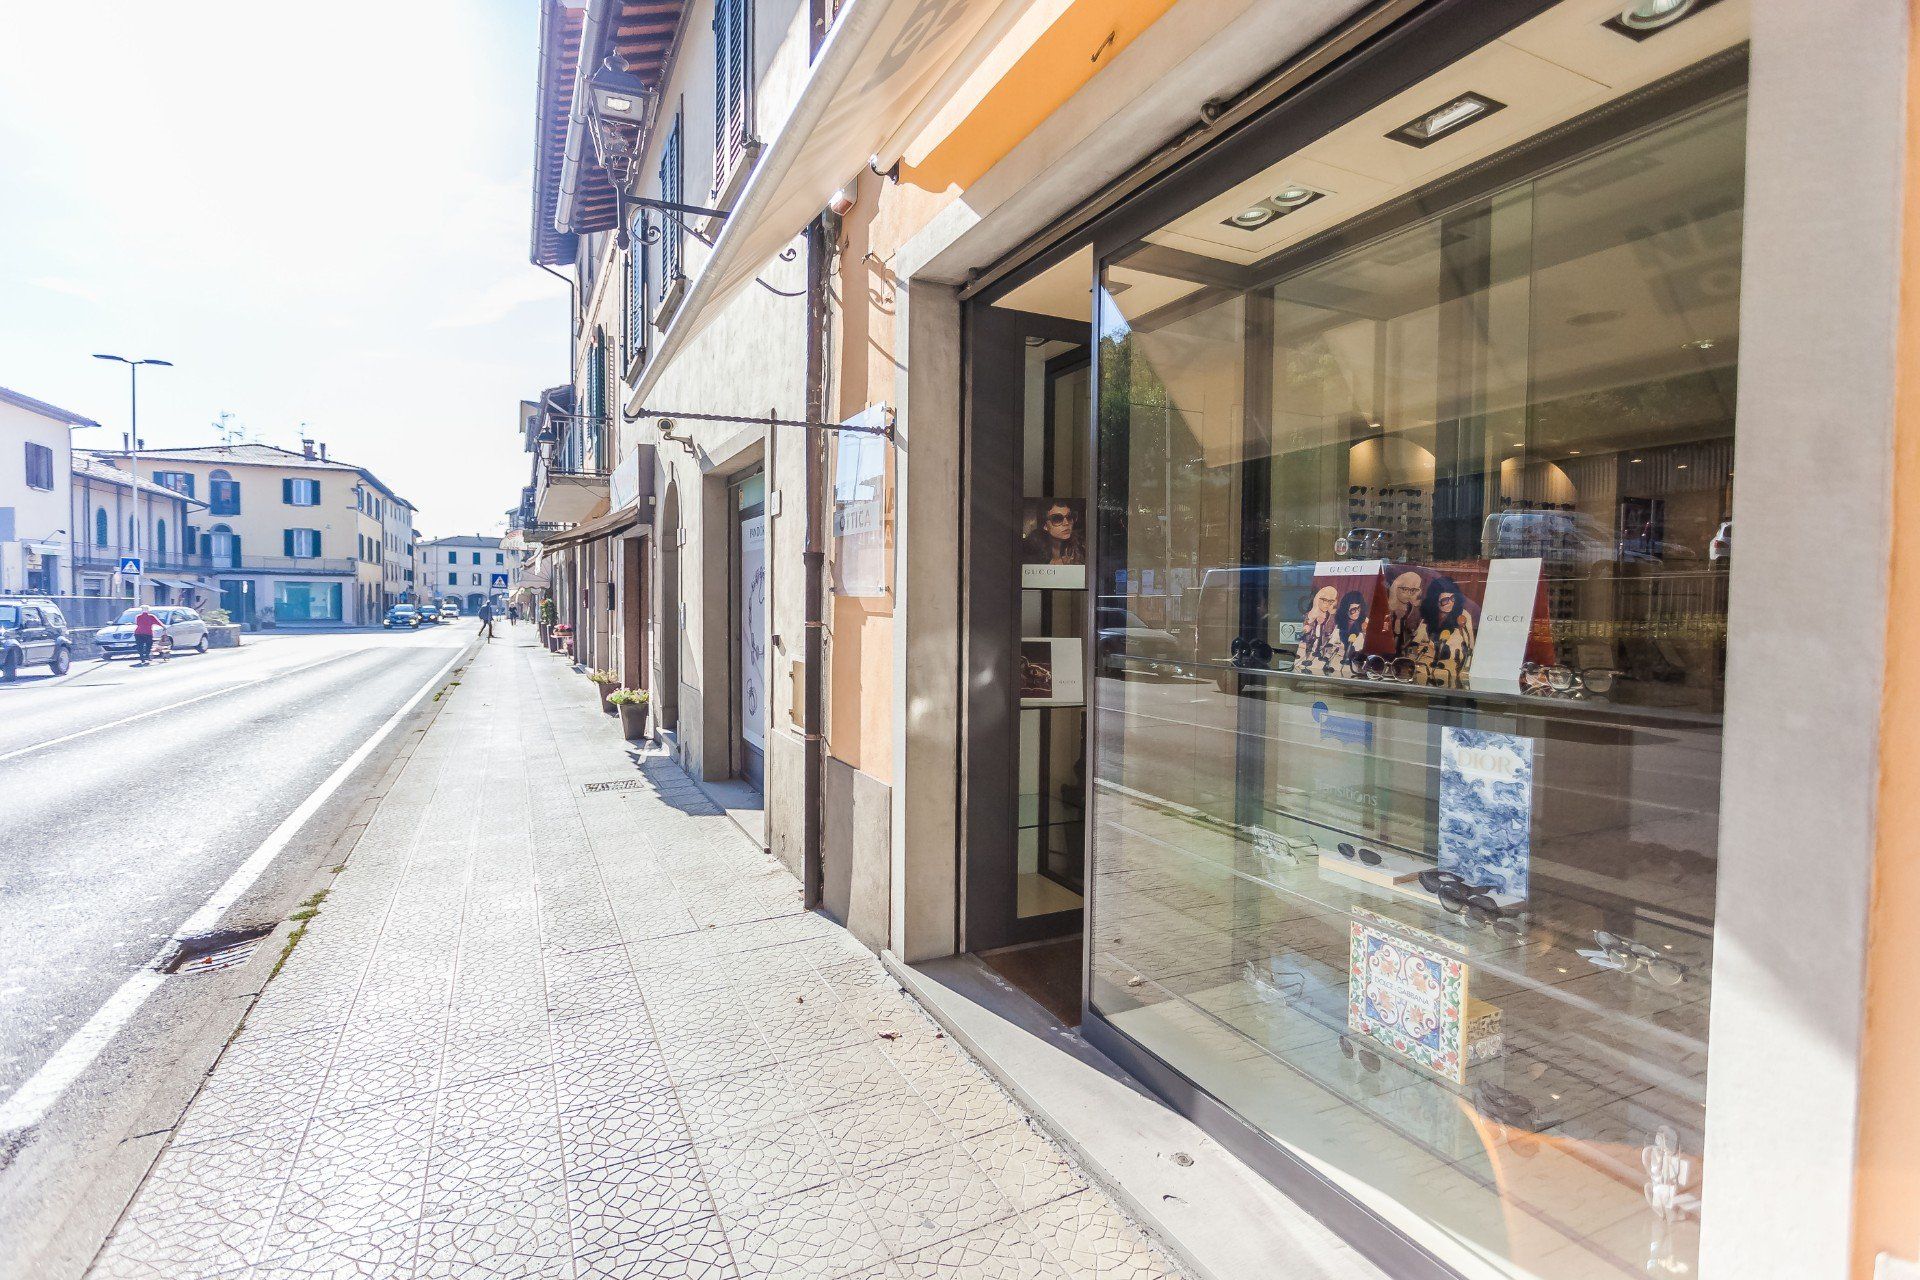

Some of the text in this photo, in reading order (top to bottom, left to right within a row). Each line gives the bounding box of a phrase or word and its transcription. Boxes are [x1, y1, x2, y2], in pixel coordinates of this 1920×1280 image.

[1024, 568, 1056, 576] GUCCI
[1329, 565, 1363, 573] GUCCI
[1486, 614, 1524, 623] GUCCI
[1458, 750, 1513, 775] DIOR
[1315, 781, 1378, 806] ansitions
[1396, 987, 1429, 1005] GABBANA
